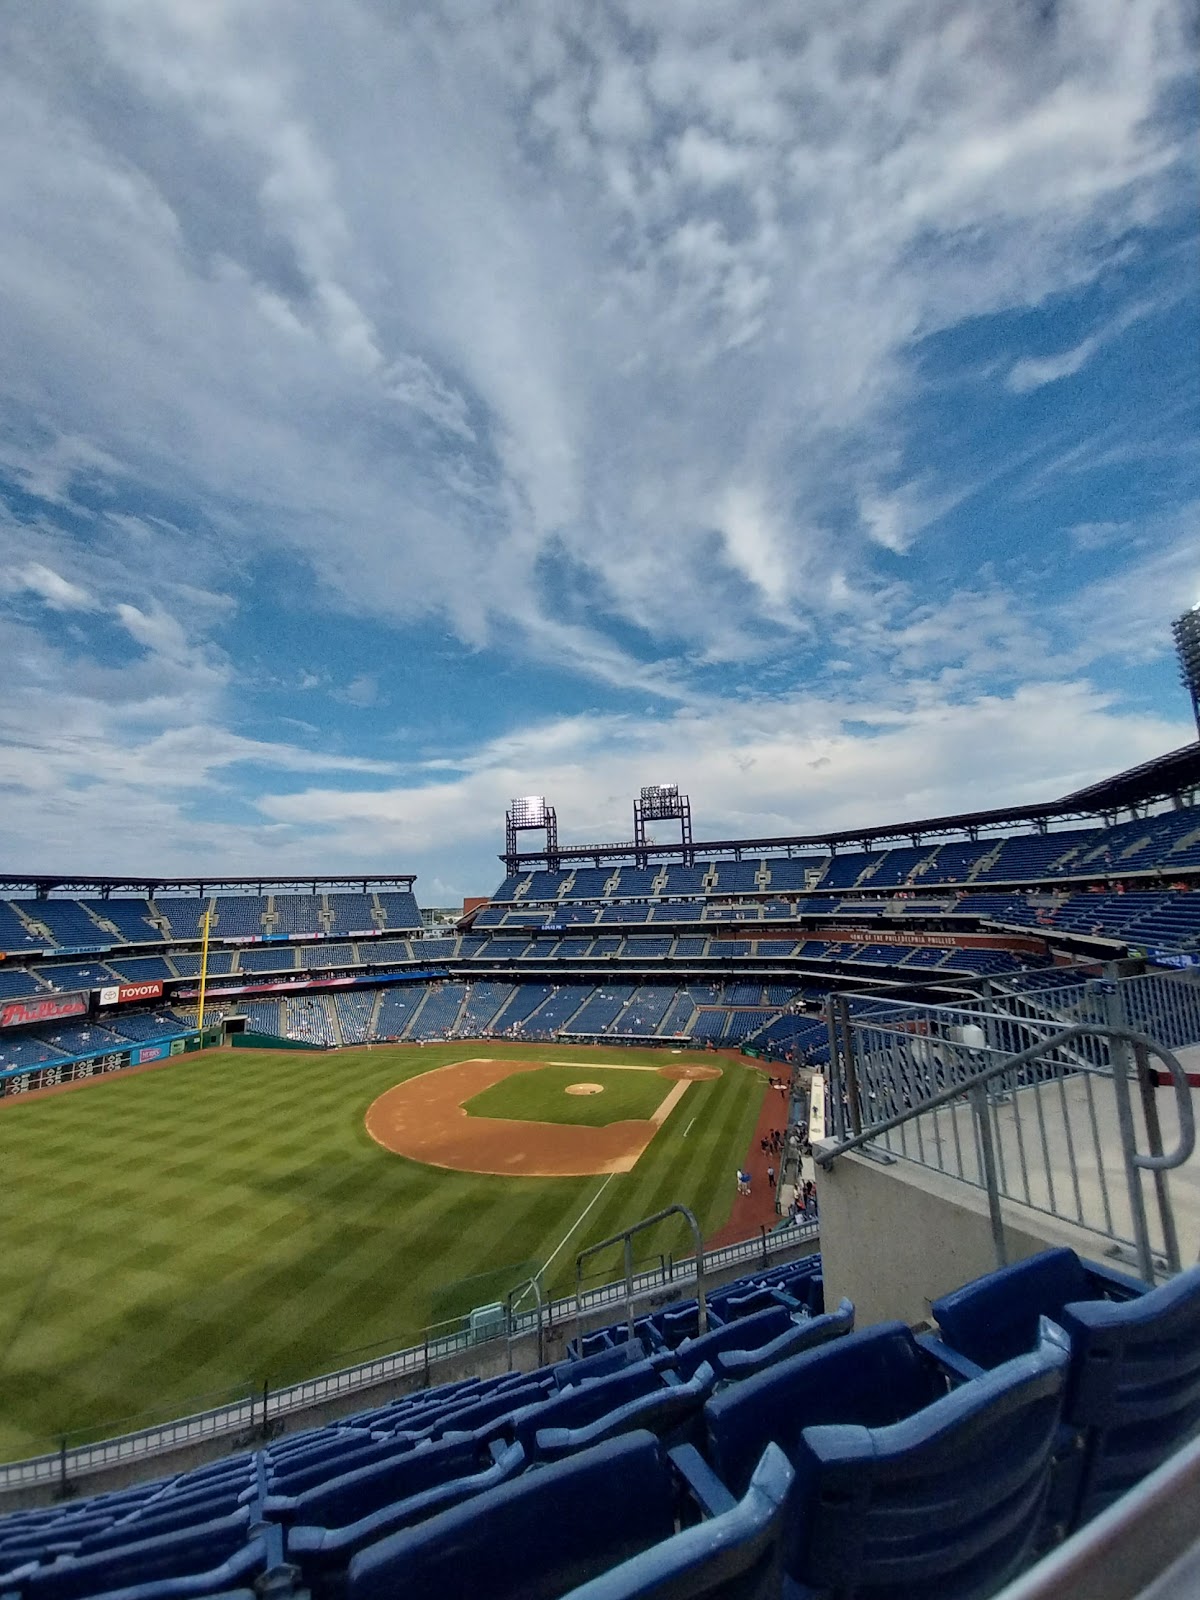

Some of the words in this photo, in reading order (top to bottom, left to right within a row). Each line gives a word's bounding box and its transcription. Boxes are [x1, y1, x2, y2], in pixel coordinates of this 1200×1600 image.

[873, 934, 883, 942] THE
[885, 935, 925, 943] PHILADELPHIA
[927, 936, 956, 945] PHILLIES
[121, 985, 160, 998] TOYOTA
[1, 1001, 86, 1024] Phillies
